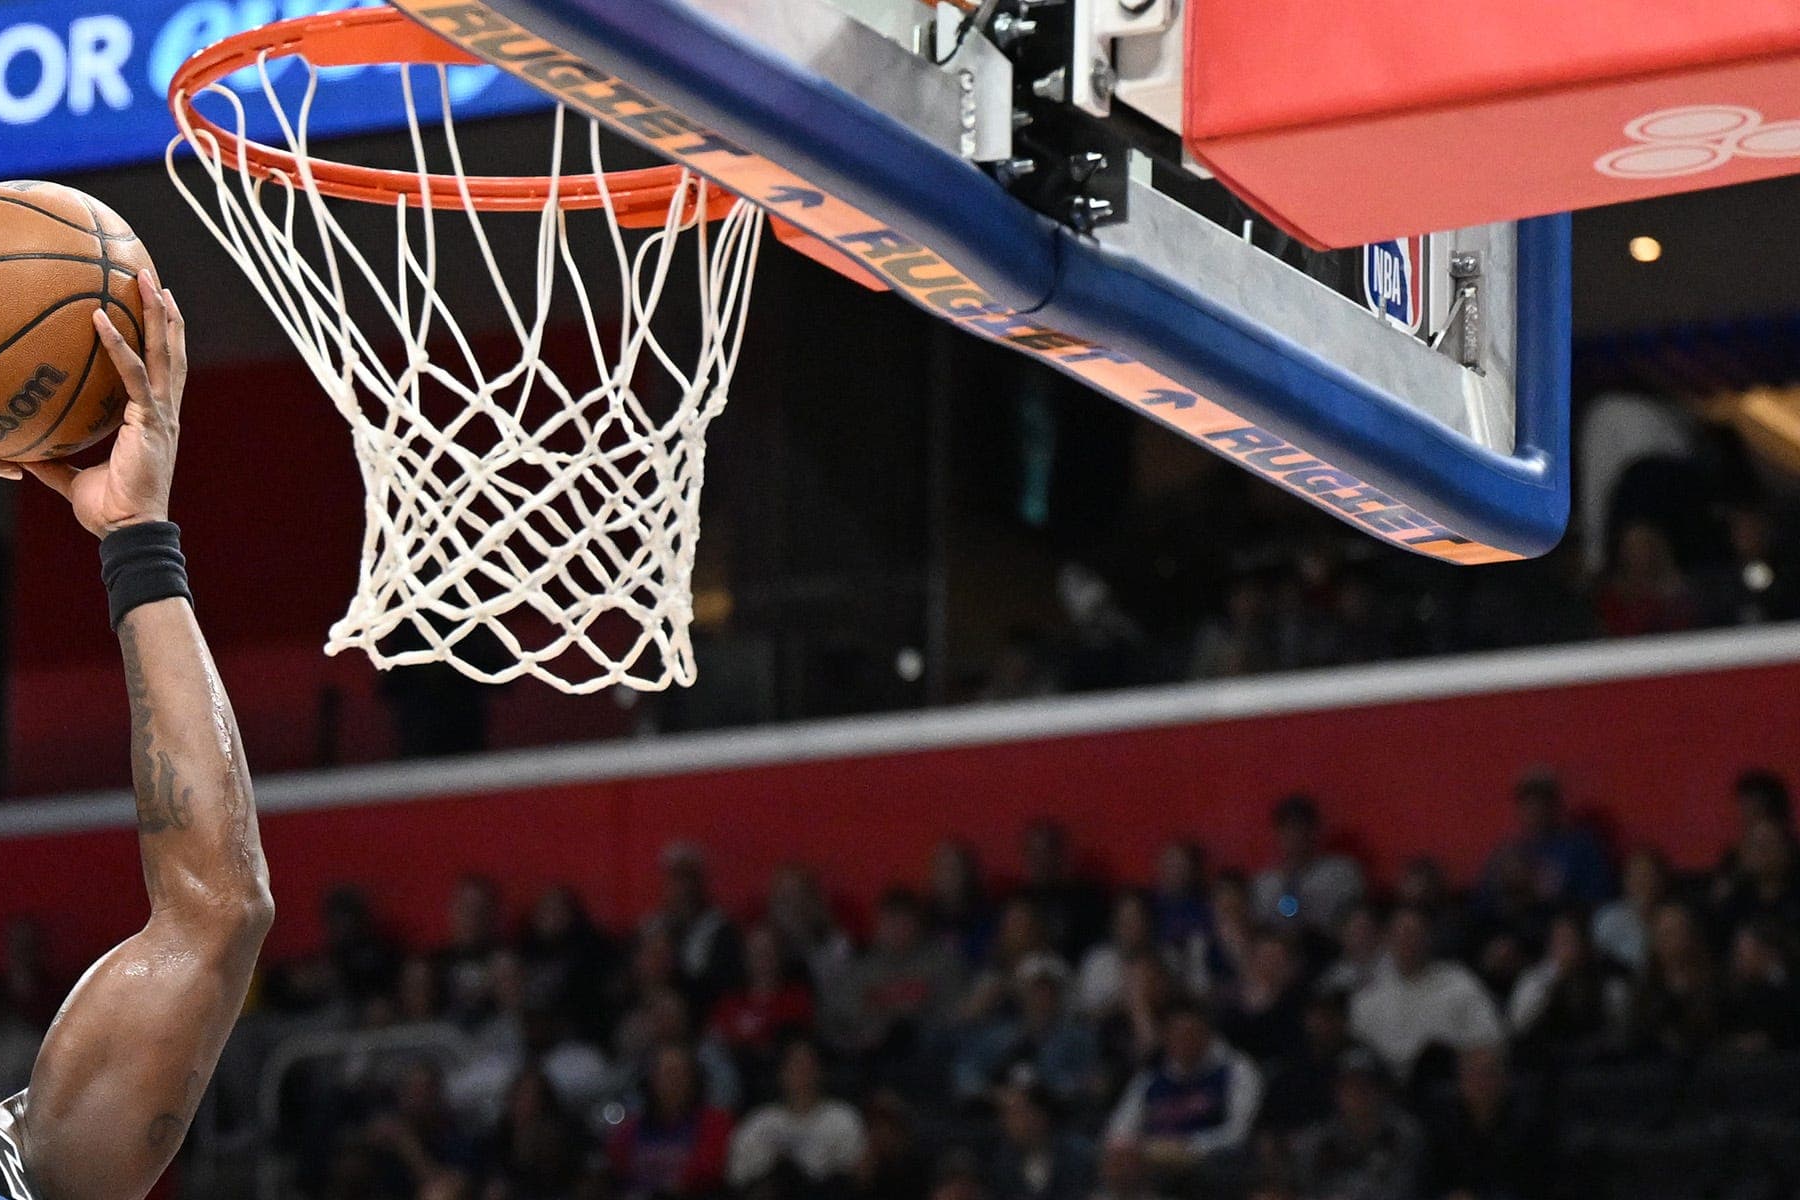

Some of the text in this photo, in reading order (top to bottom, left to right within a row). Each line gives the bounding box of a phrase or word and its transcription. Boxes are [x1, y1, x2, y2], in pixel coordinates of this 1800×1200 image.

[417, 5, 752, 156] RUGIET
[837, 229, 1137, 364] RUGIET
[1373, 245, 1401, 306] NBA
[1204, 426, 1473, 544] RUGIET
